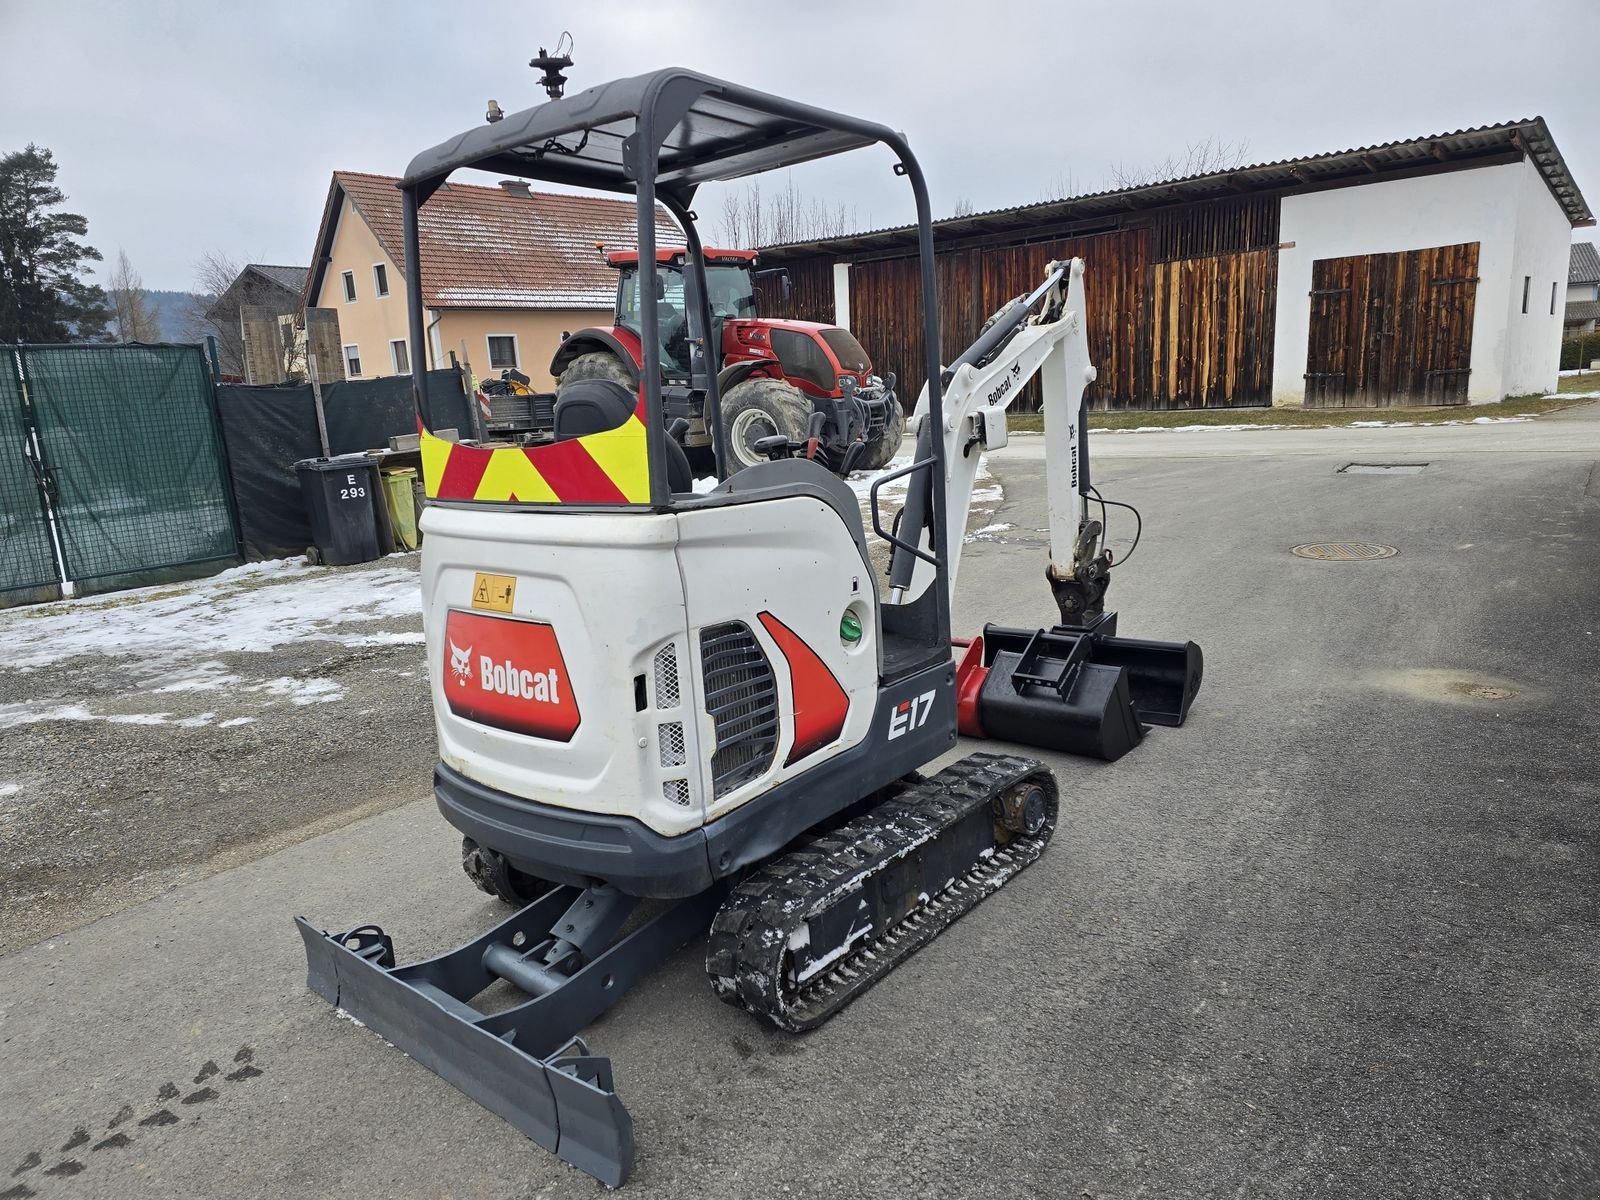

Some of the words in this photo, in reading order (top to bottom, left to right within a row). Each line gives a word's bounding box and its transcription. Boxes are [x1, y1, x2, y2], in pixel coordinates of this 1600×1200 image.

[988, 375, 1011, 407] Bobcat
[340, 487, 366, 500] 293
[347, 474, 356, 485] E
[480, 655, 560, 704] Bobcat
[888, 689, 936, 741] E17
